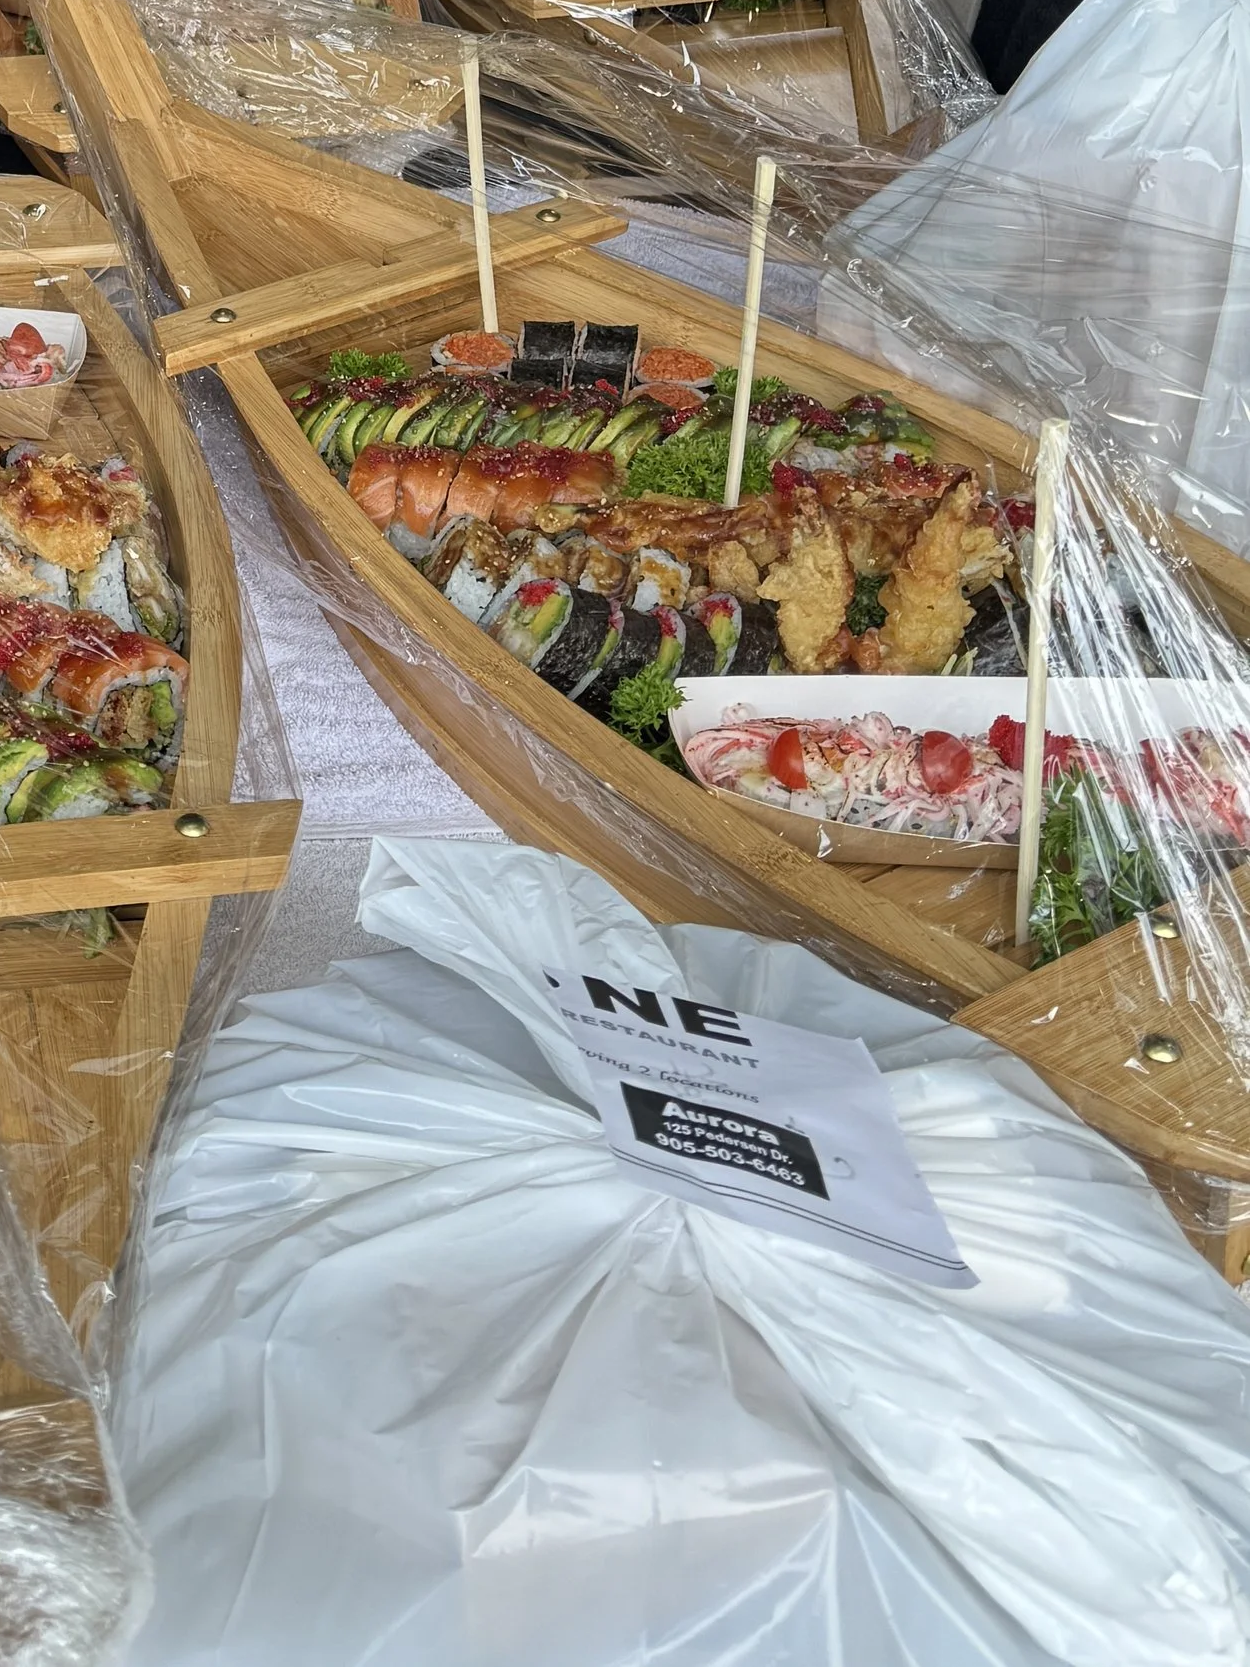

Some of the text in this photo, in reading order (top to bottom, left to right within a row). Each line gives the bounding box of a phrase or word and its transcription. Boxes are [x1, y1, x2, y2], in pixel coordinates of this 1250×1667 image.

[560, 1007, 759, 1069] RESTAURANT
[638, 1065, 651, 1076] 2
[660, 1070, 760, 1104] locations
[661, 1101, 780, 1146] Aurora
[663, 1121, 794, 1165] 125 Pedersen Dr.
[655, 1132, 806, 1186] 905-503-6463
